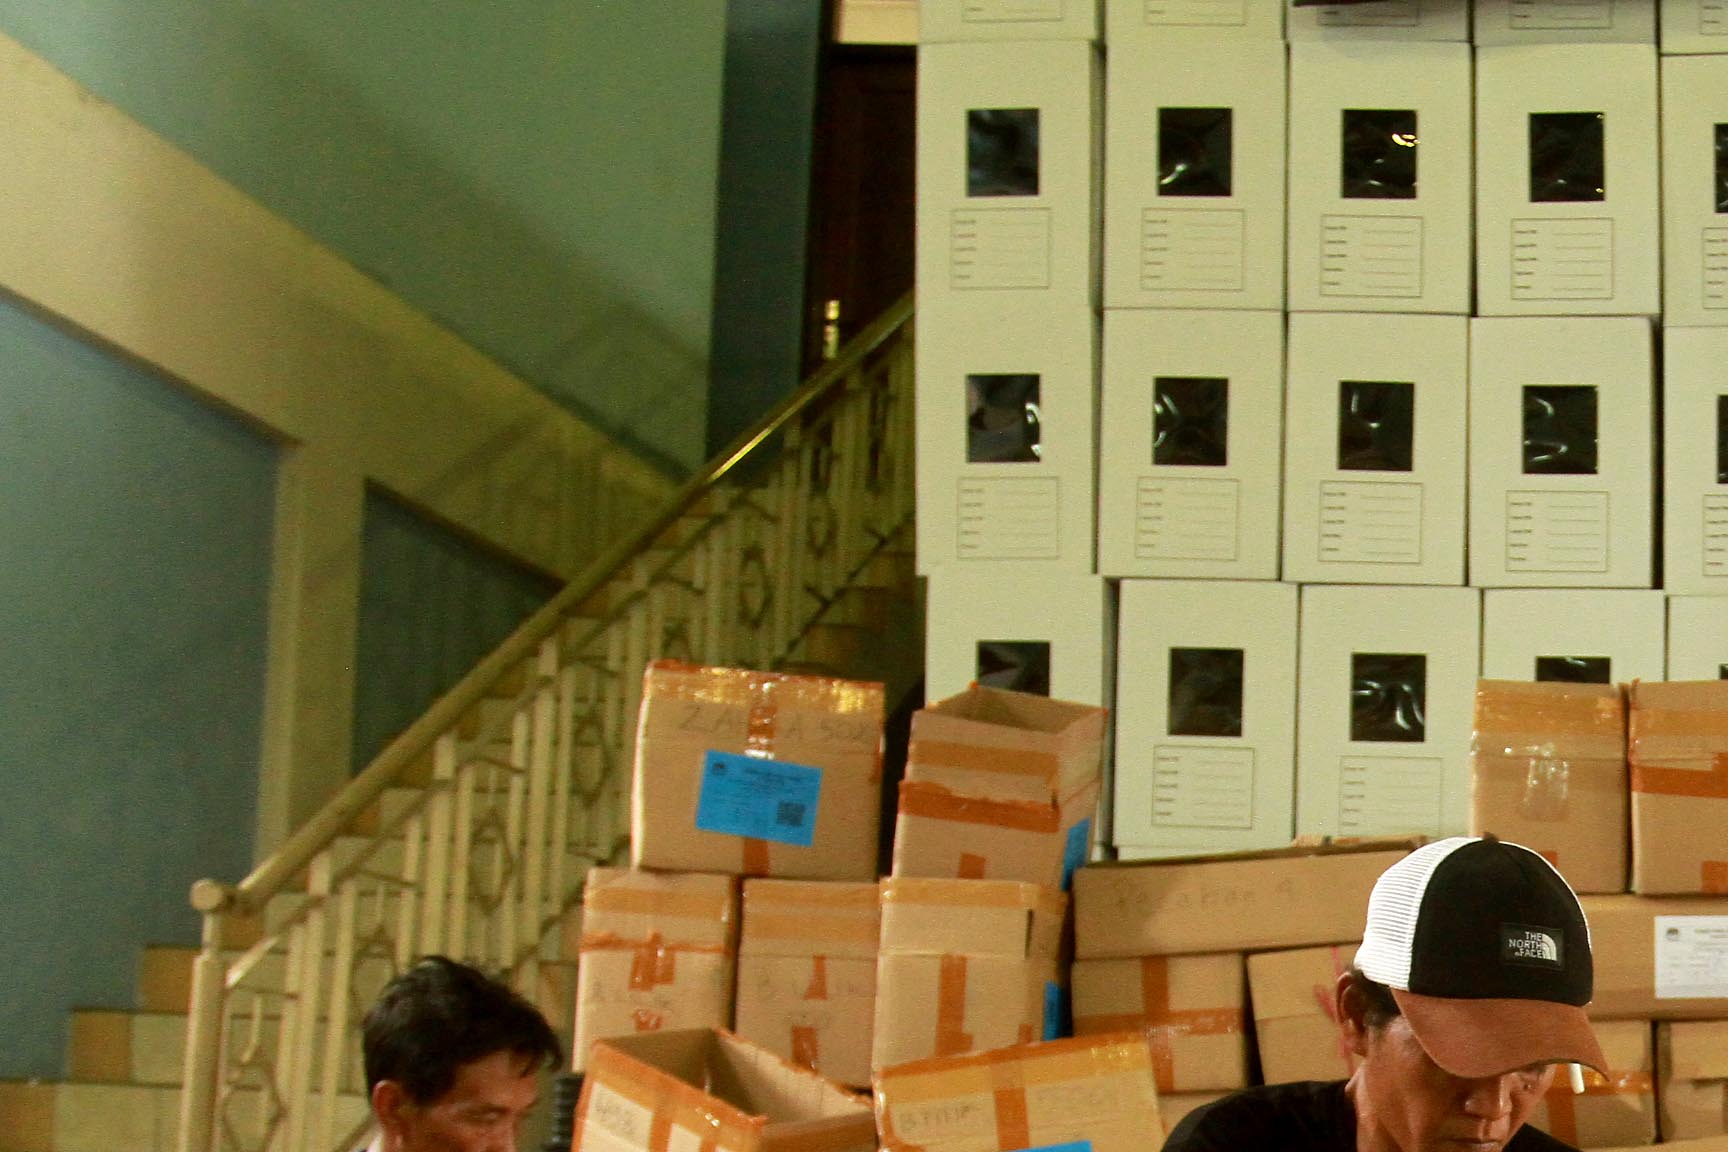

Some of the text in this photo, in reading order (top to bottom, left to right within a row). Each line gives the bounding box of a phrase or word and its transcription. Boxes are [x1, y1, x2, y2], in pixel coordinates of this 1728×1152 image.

[1525, 931, 1542, 941] THE
[1508, 938, 1542, 950] NORTH
[1519, 948, 1543, 958] FACE
